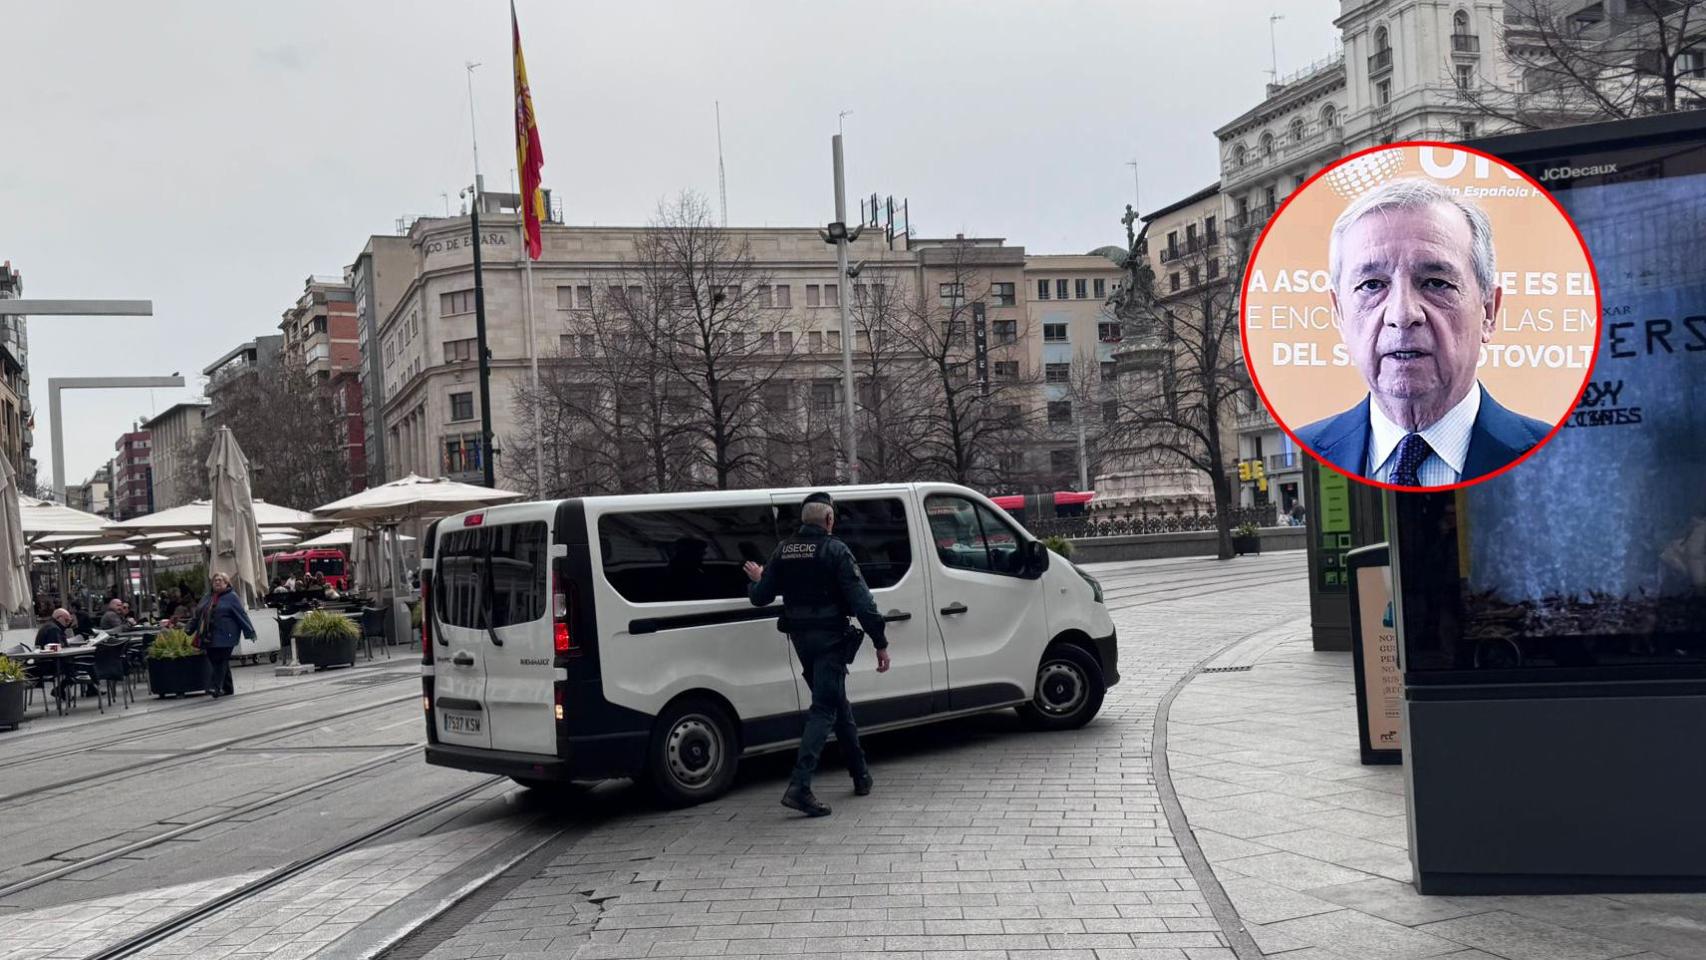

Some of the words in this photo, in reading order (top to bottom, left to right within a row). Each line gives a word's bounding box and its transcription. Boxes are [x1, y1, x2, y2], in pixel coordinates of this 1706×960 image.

[1540, 163, 1618, 181] JCDecaux
[1464, 185, 1532, 198] Española
[446, 239, 459, 250] DE
[463, 233, 506, 248] EAÑA
[1525, 271, 1559, 296] ES
[1248, 305, 1263, 329] E
[1503, 308, 1554, 332] LAS
[1272, 342, 1328, 367] DEL
[782, 543, 816, 553] USECIC
